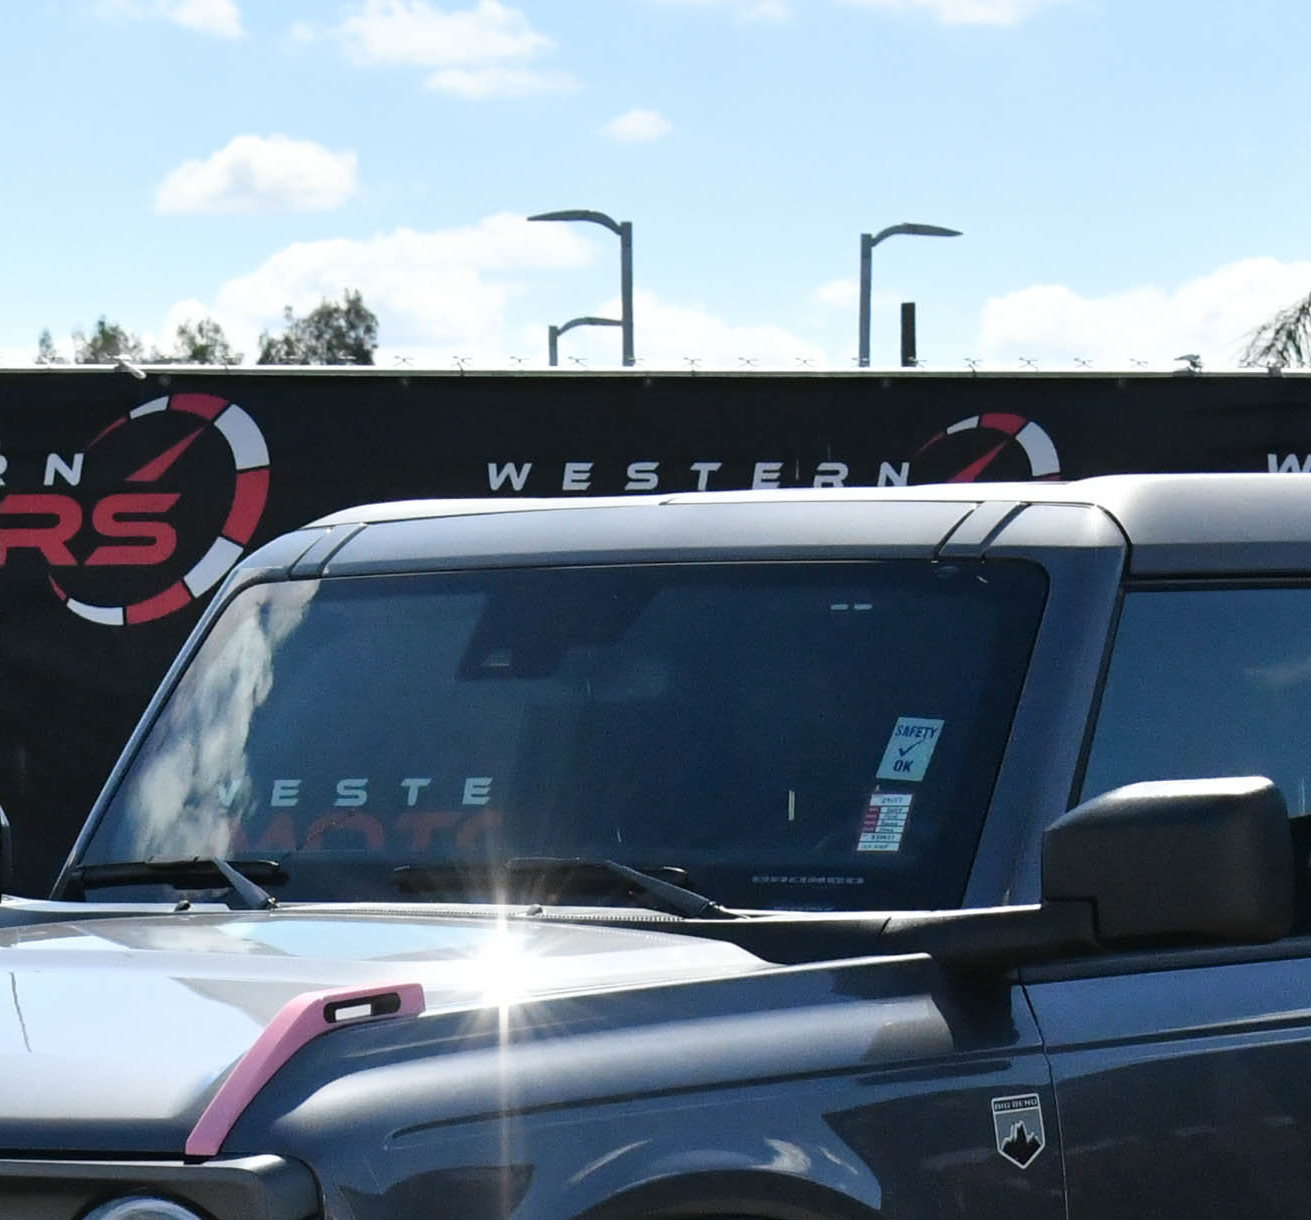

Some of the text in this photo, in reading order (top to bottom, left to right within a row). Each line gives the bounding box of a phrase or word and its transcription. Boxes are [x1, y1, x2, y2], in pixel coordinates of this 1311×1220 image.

[488, 462, 910, 492] WESTERN
[895, 724, 938, 739] SAFETY
[893, 759, 913, 773] OK
